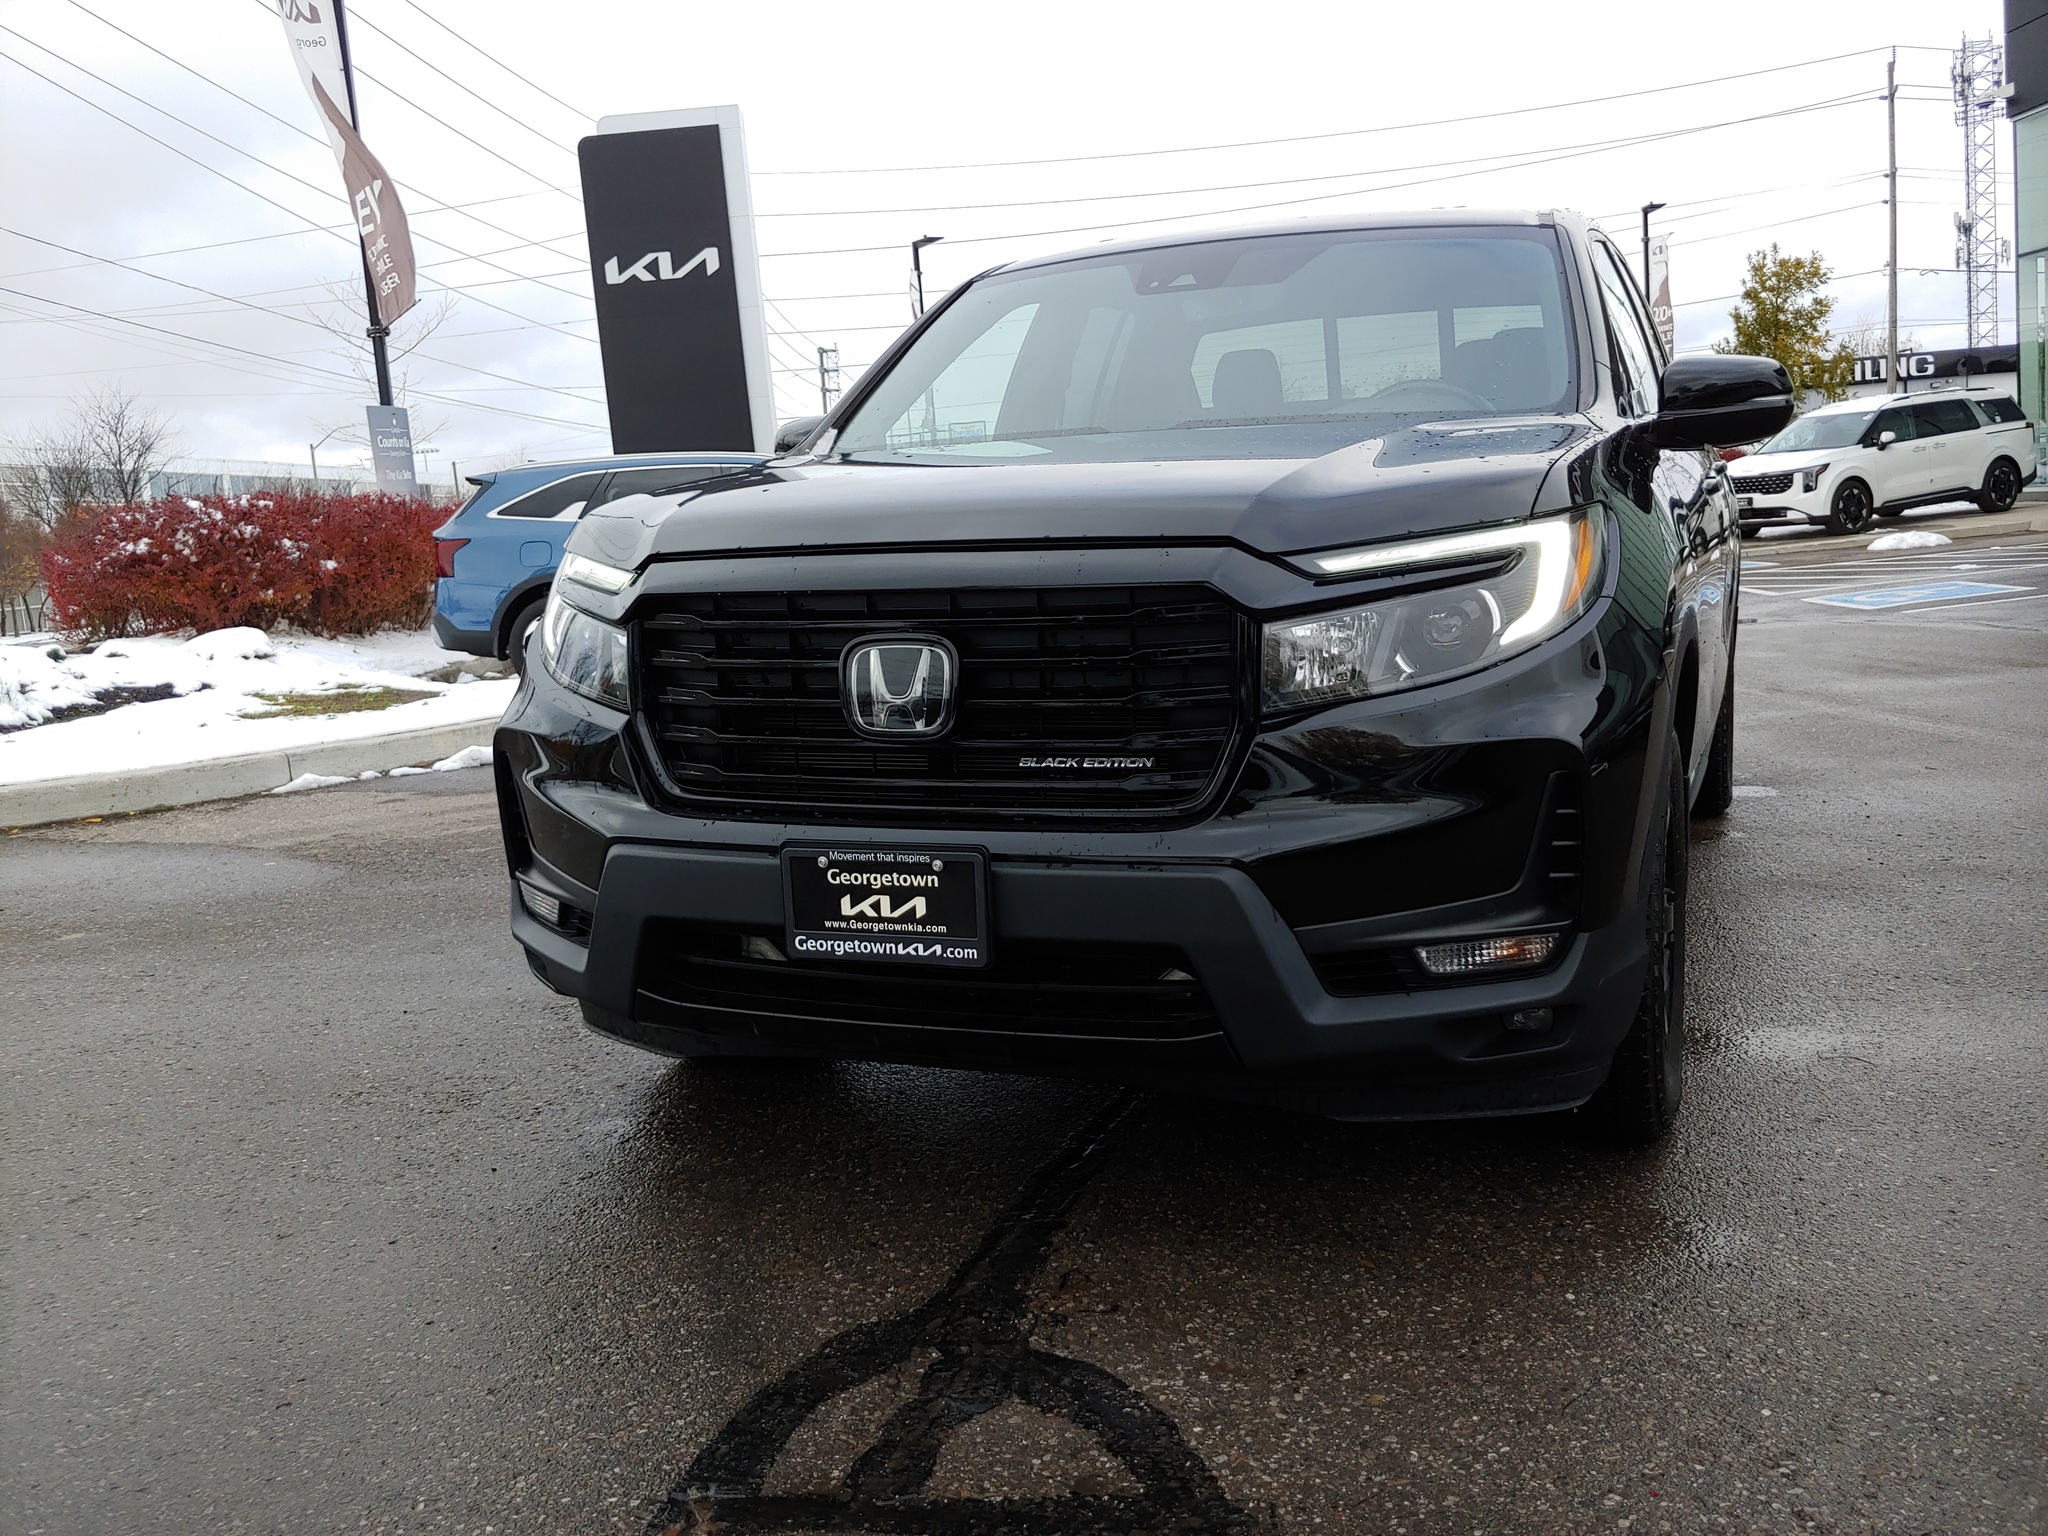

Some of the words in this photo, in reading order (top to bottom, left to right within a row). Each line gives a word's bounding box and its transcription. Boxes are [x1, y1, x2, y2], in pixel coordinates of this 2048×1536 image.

[604, 247, 720, 285] KIA
[1018, 757, 1081, 768] BLACK
[1082, 757, 1155, 768] EDITION
[829, 851, 875, 862] Movement
[876, 852, 895, 862] that
[896, 852, 930, 866] inspires
[826, 868, 939, 889] Georgetown
[840, 893, 927, 919] KIA
[824, 919, 947, 934] www.Georgetownkia.com
